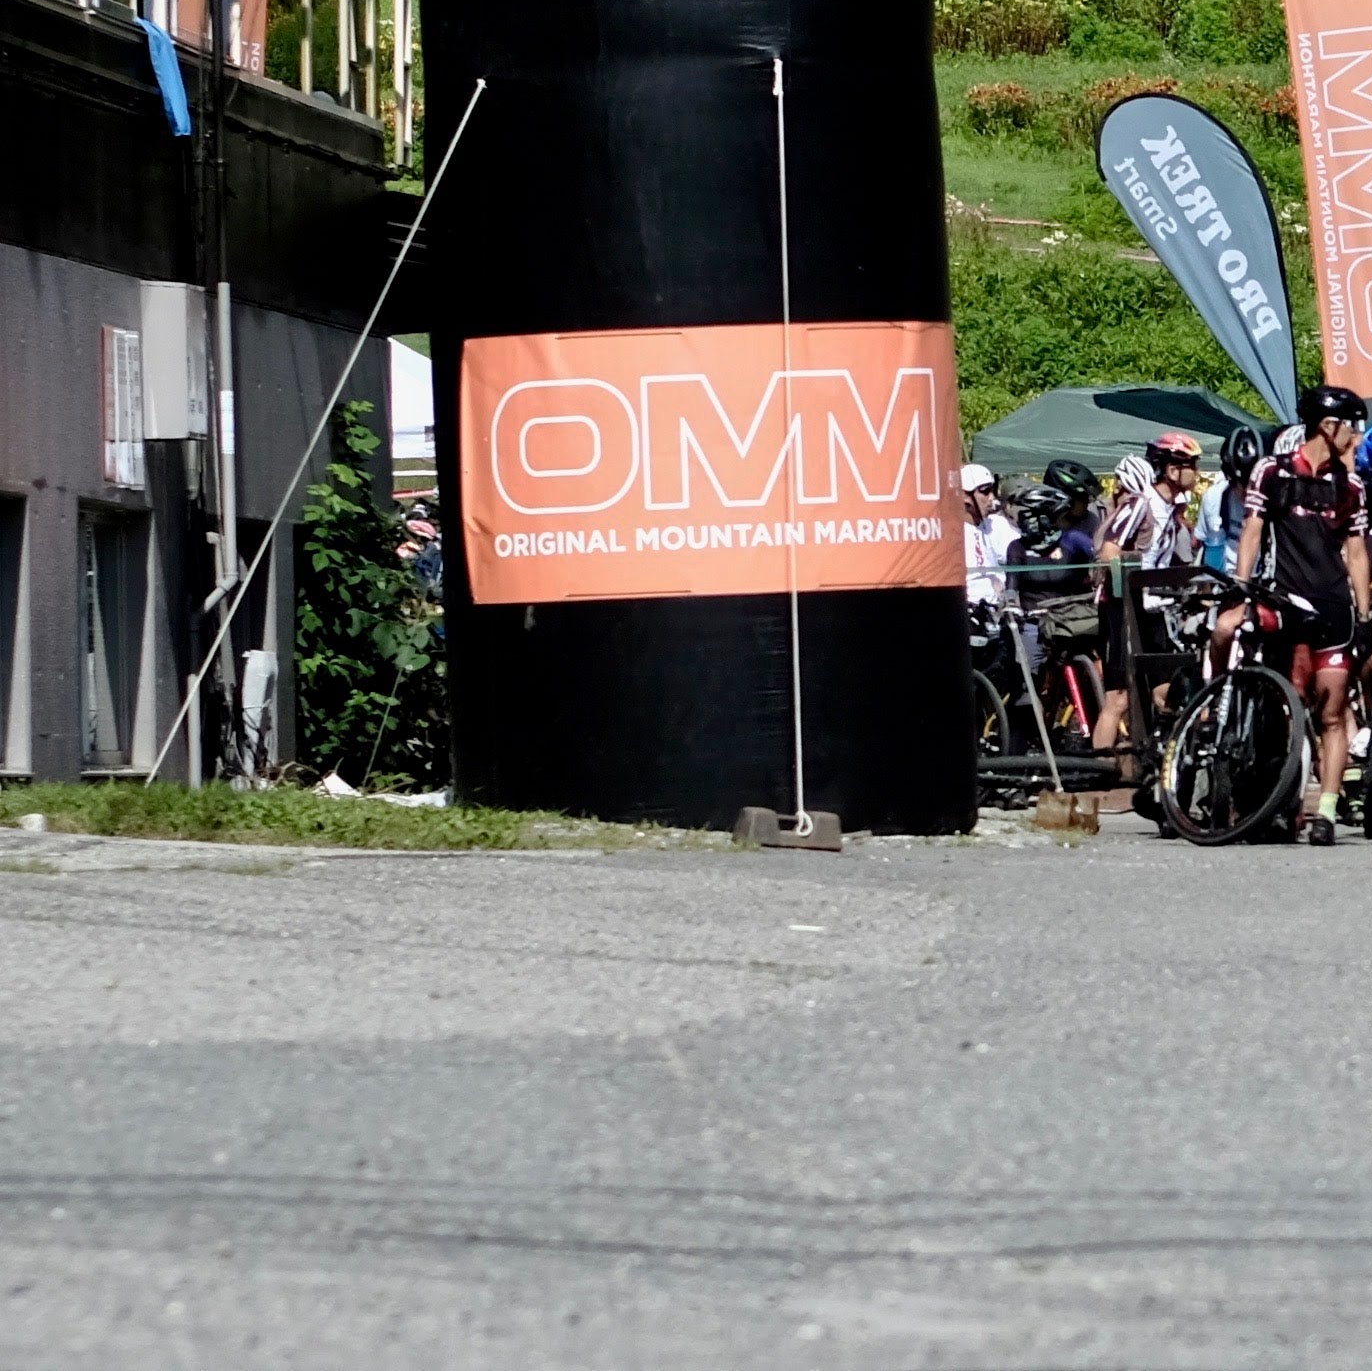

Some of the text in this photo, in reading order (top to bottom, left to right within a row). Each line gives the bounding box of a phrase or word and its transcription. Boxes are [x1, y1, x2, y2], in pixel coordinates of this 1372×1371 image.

[489, 368, 941, 515] OMM
[494, 517, 942, 558] ORIGINAL MOUNTAIN MARATHON
